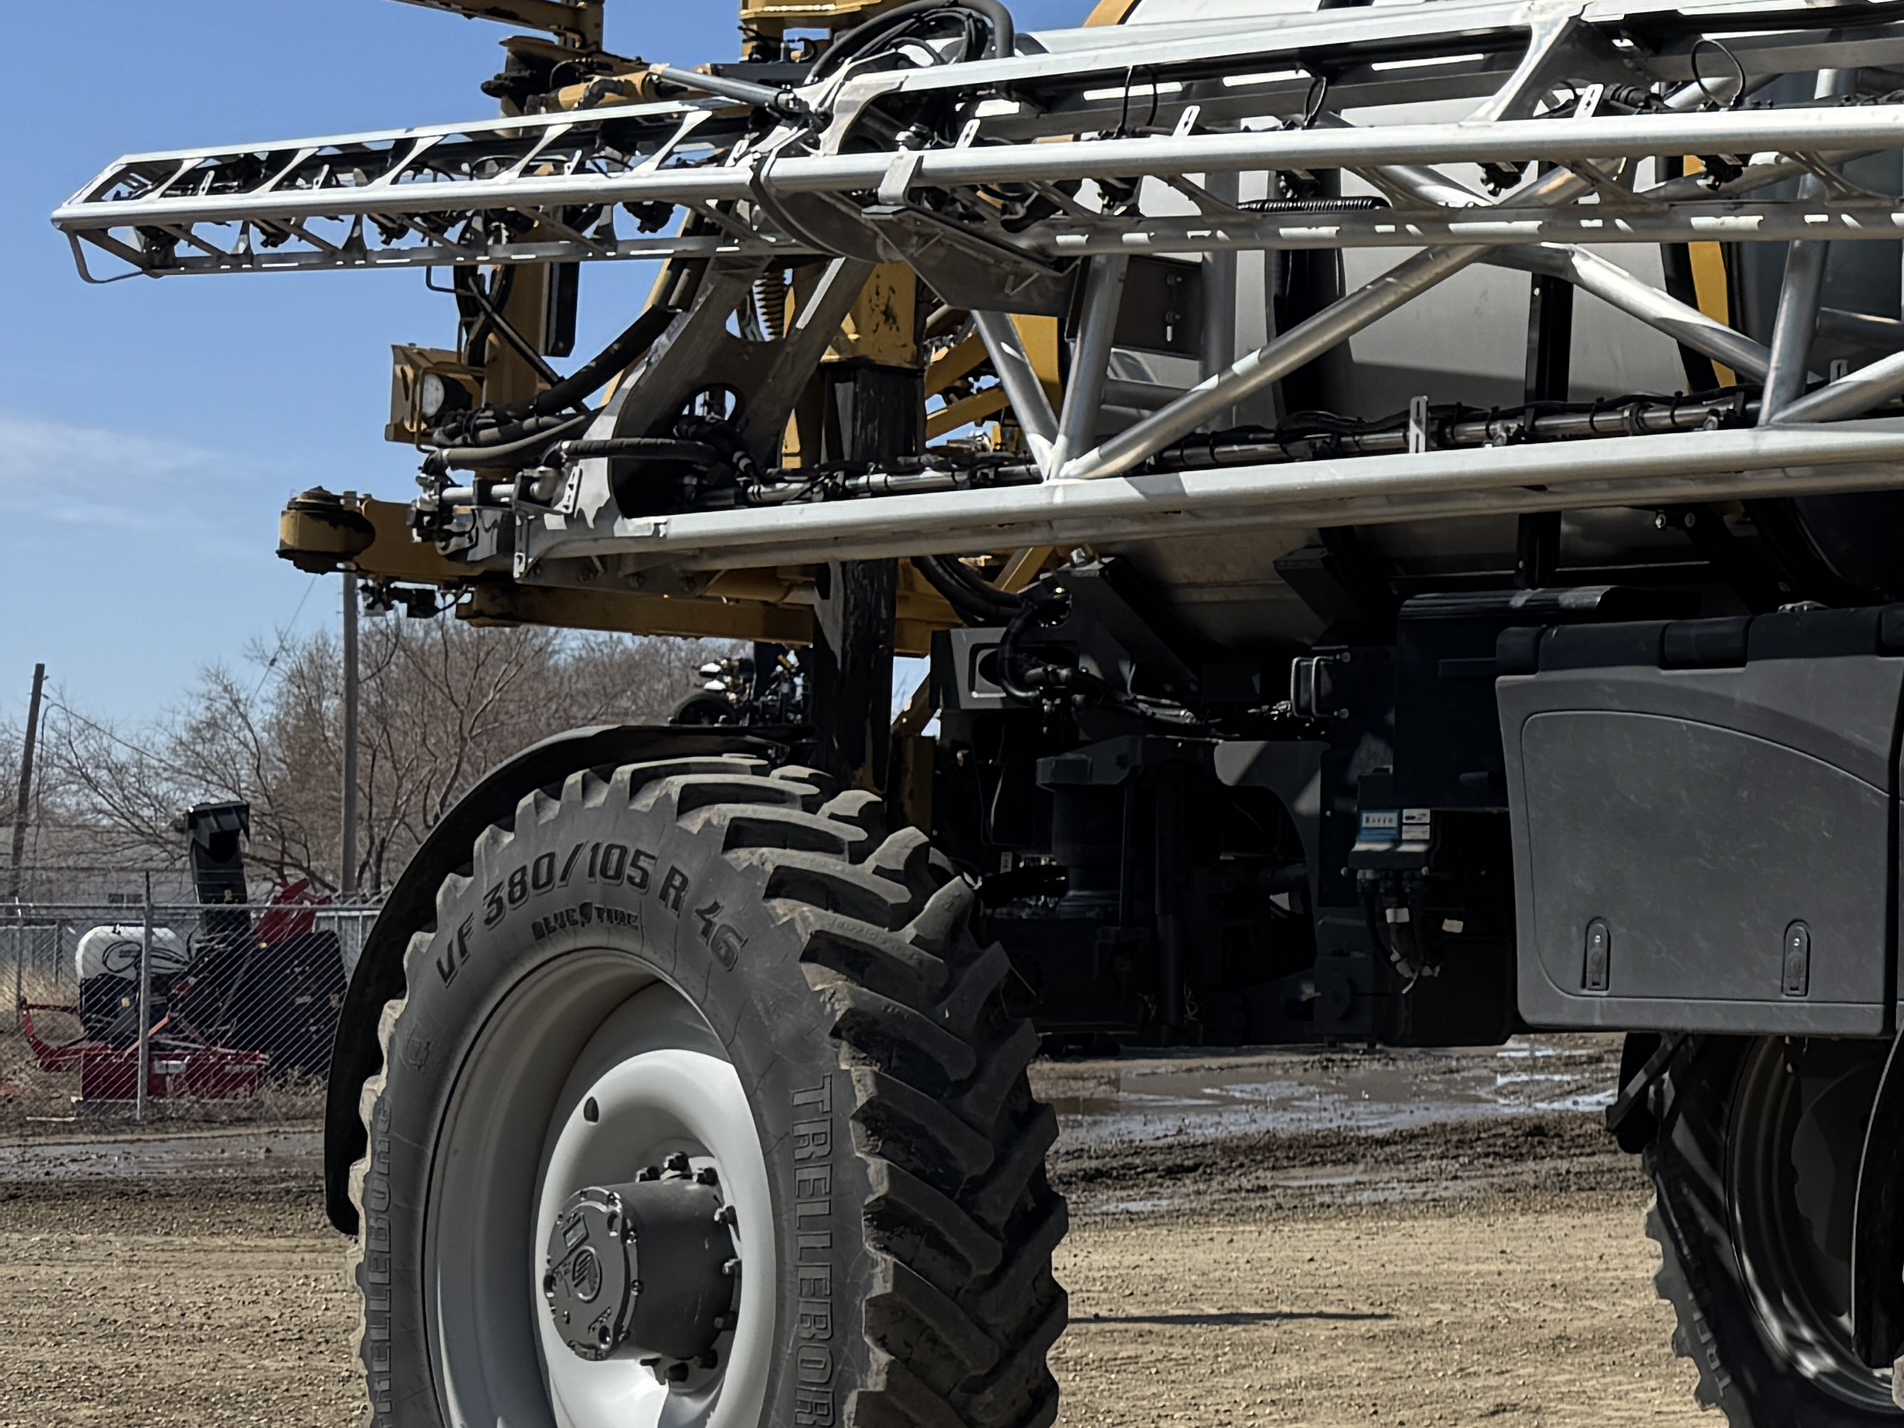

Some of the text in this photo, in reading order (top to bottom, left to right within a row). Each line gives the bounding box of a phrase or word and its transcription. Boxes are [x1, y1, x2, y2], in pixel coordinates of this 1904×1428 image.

[436, 840, 749, 988] VF 380/105 R 46
[530, 904, 640, 941] BLUE TIRE
